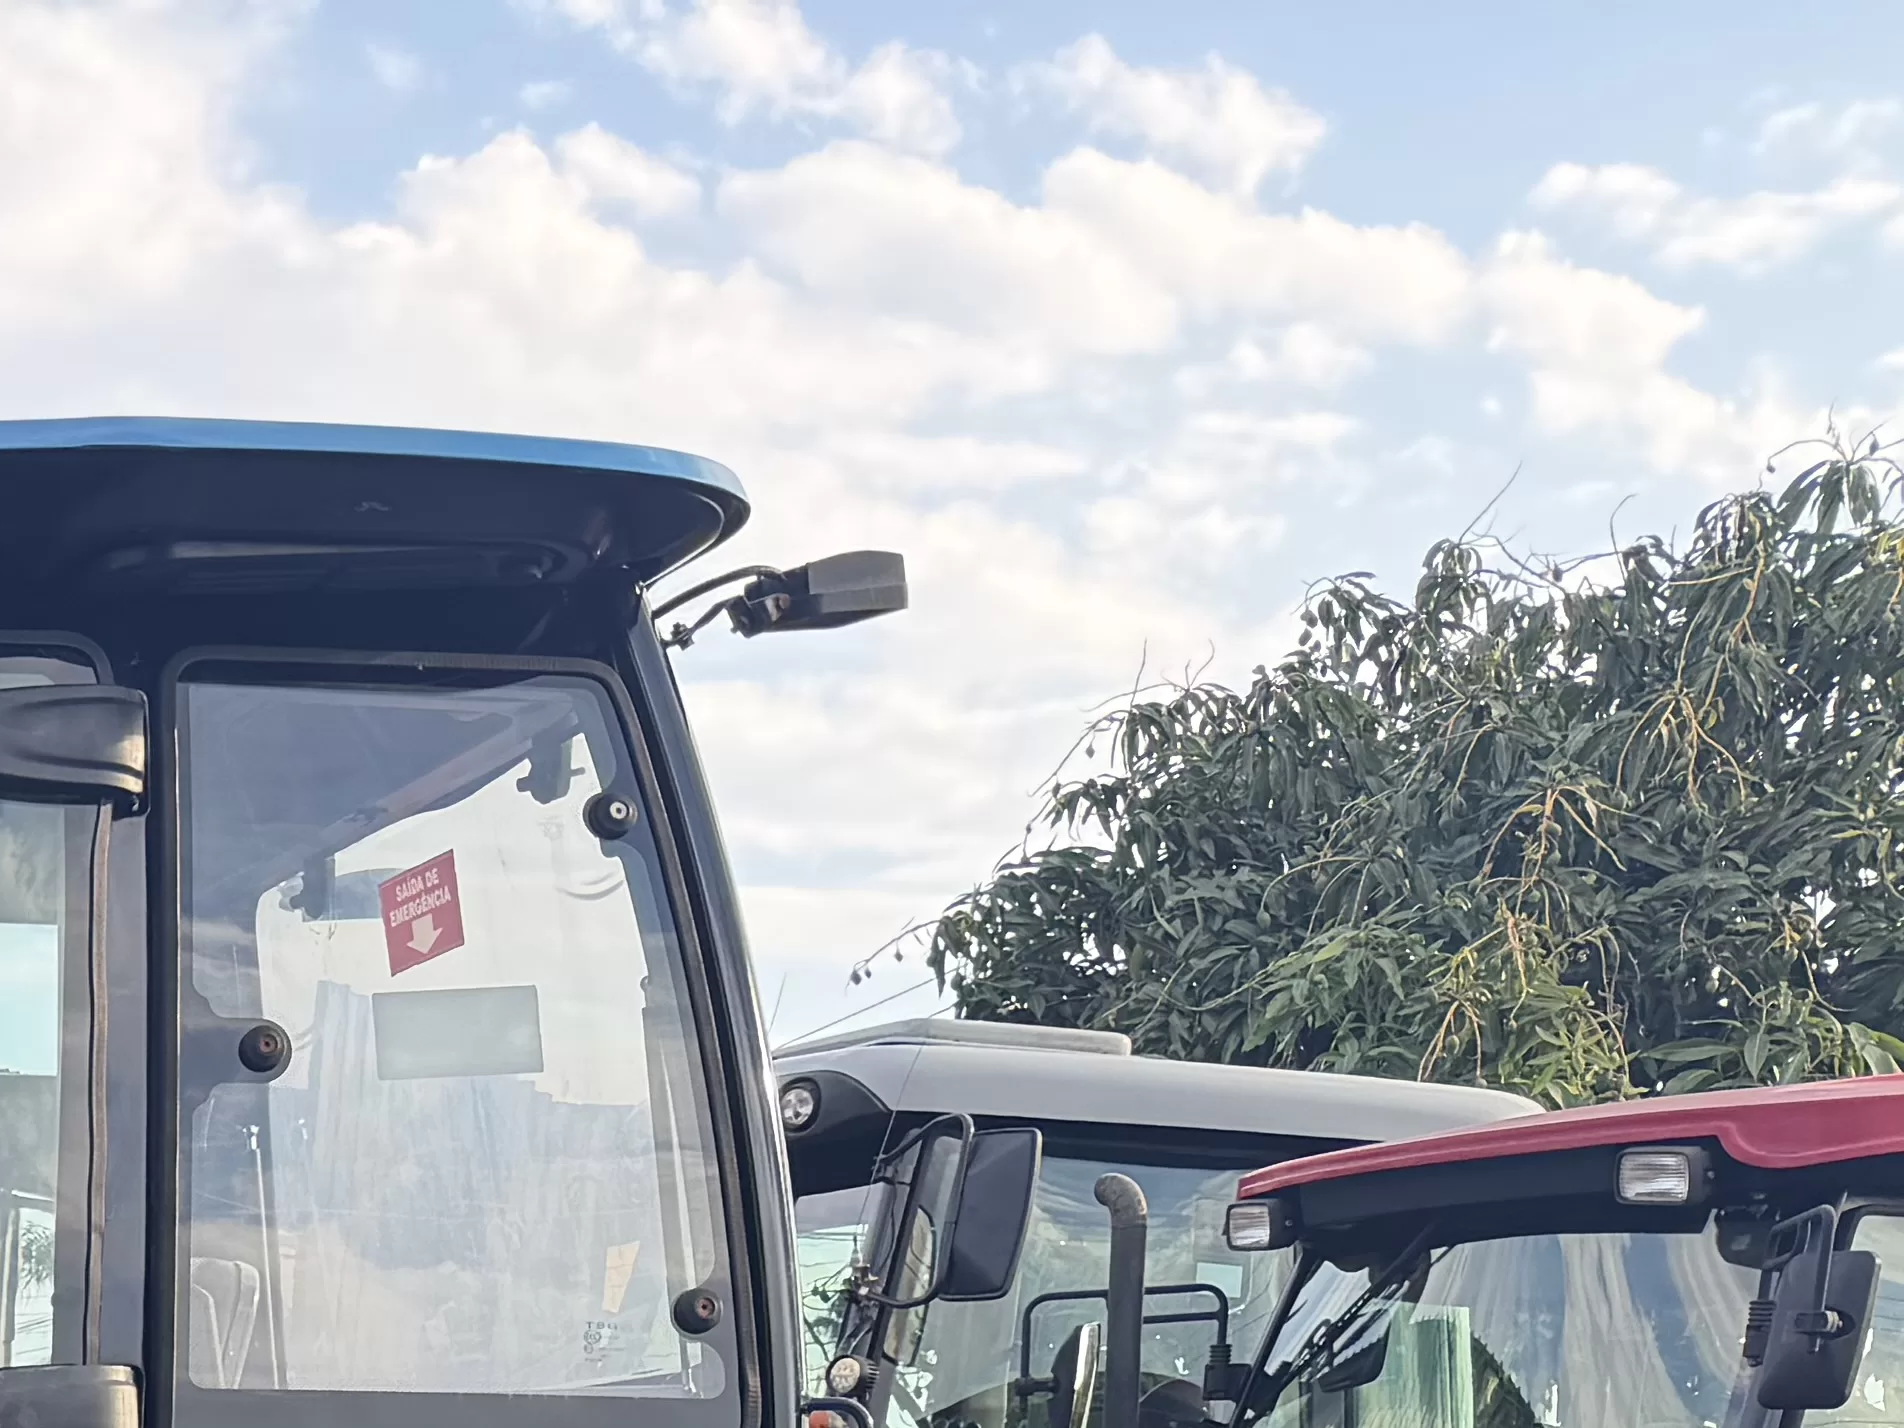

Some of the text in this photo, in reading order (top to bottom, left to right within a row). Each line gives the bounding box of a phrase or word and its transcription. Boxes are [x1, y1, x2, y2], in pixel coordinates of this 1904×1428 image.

[396, 867, 439, 902] SAÍDA DE
[389, 885, 452, 928] EMERGÊNCIA
